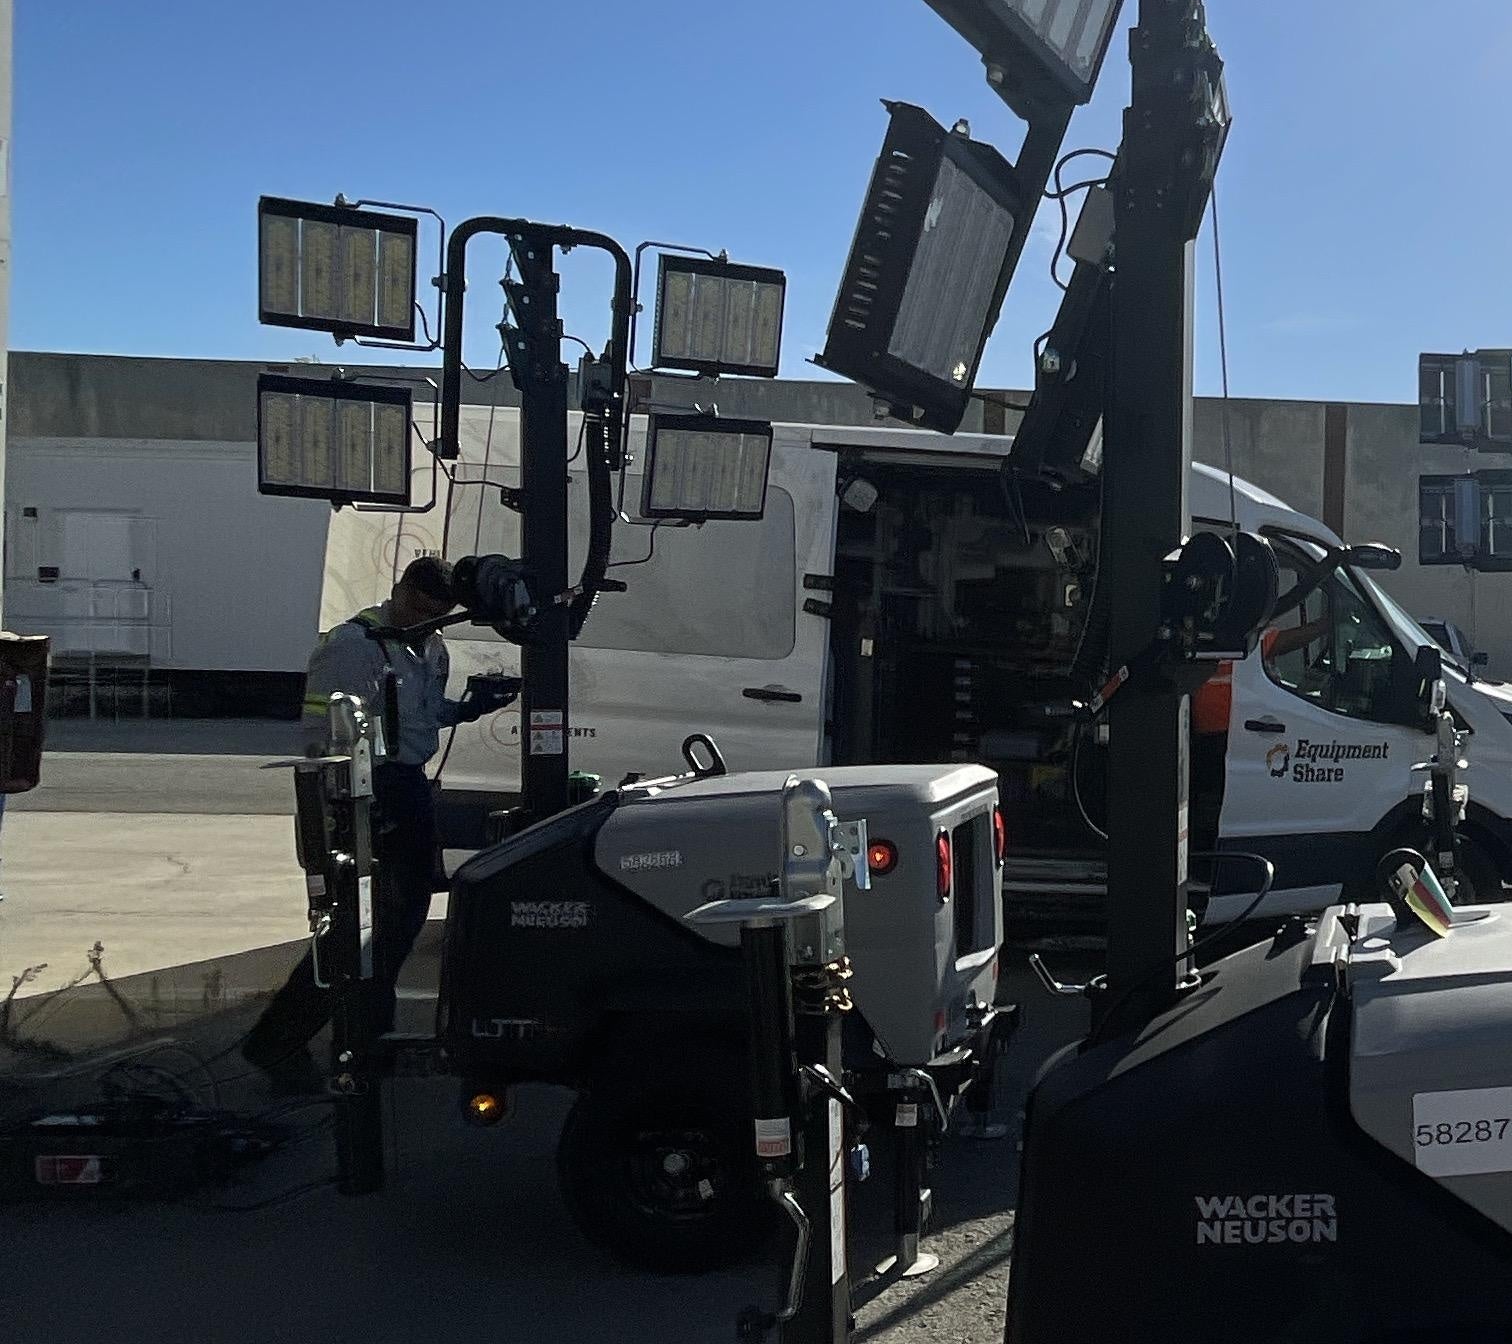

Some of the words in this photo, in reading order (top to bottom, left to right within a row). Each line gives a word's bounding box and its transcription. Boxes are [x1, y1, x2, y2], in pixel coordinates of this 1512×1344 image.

[1295, 739, 1389, 763] Equipment
[1293, 763, 1344, 782] Share
[1194, 1193, 1337, 1219] WACKER
[1196, 1218, 1337, 1245] NEUSON
